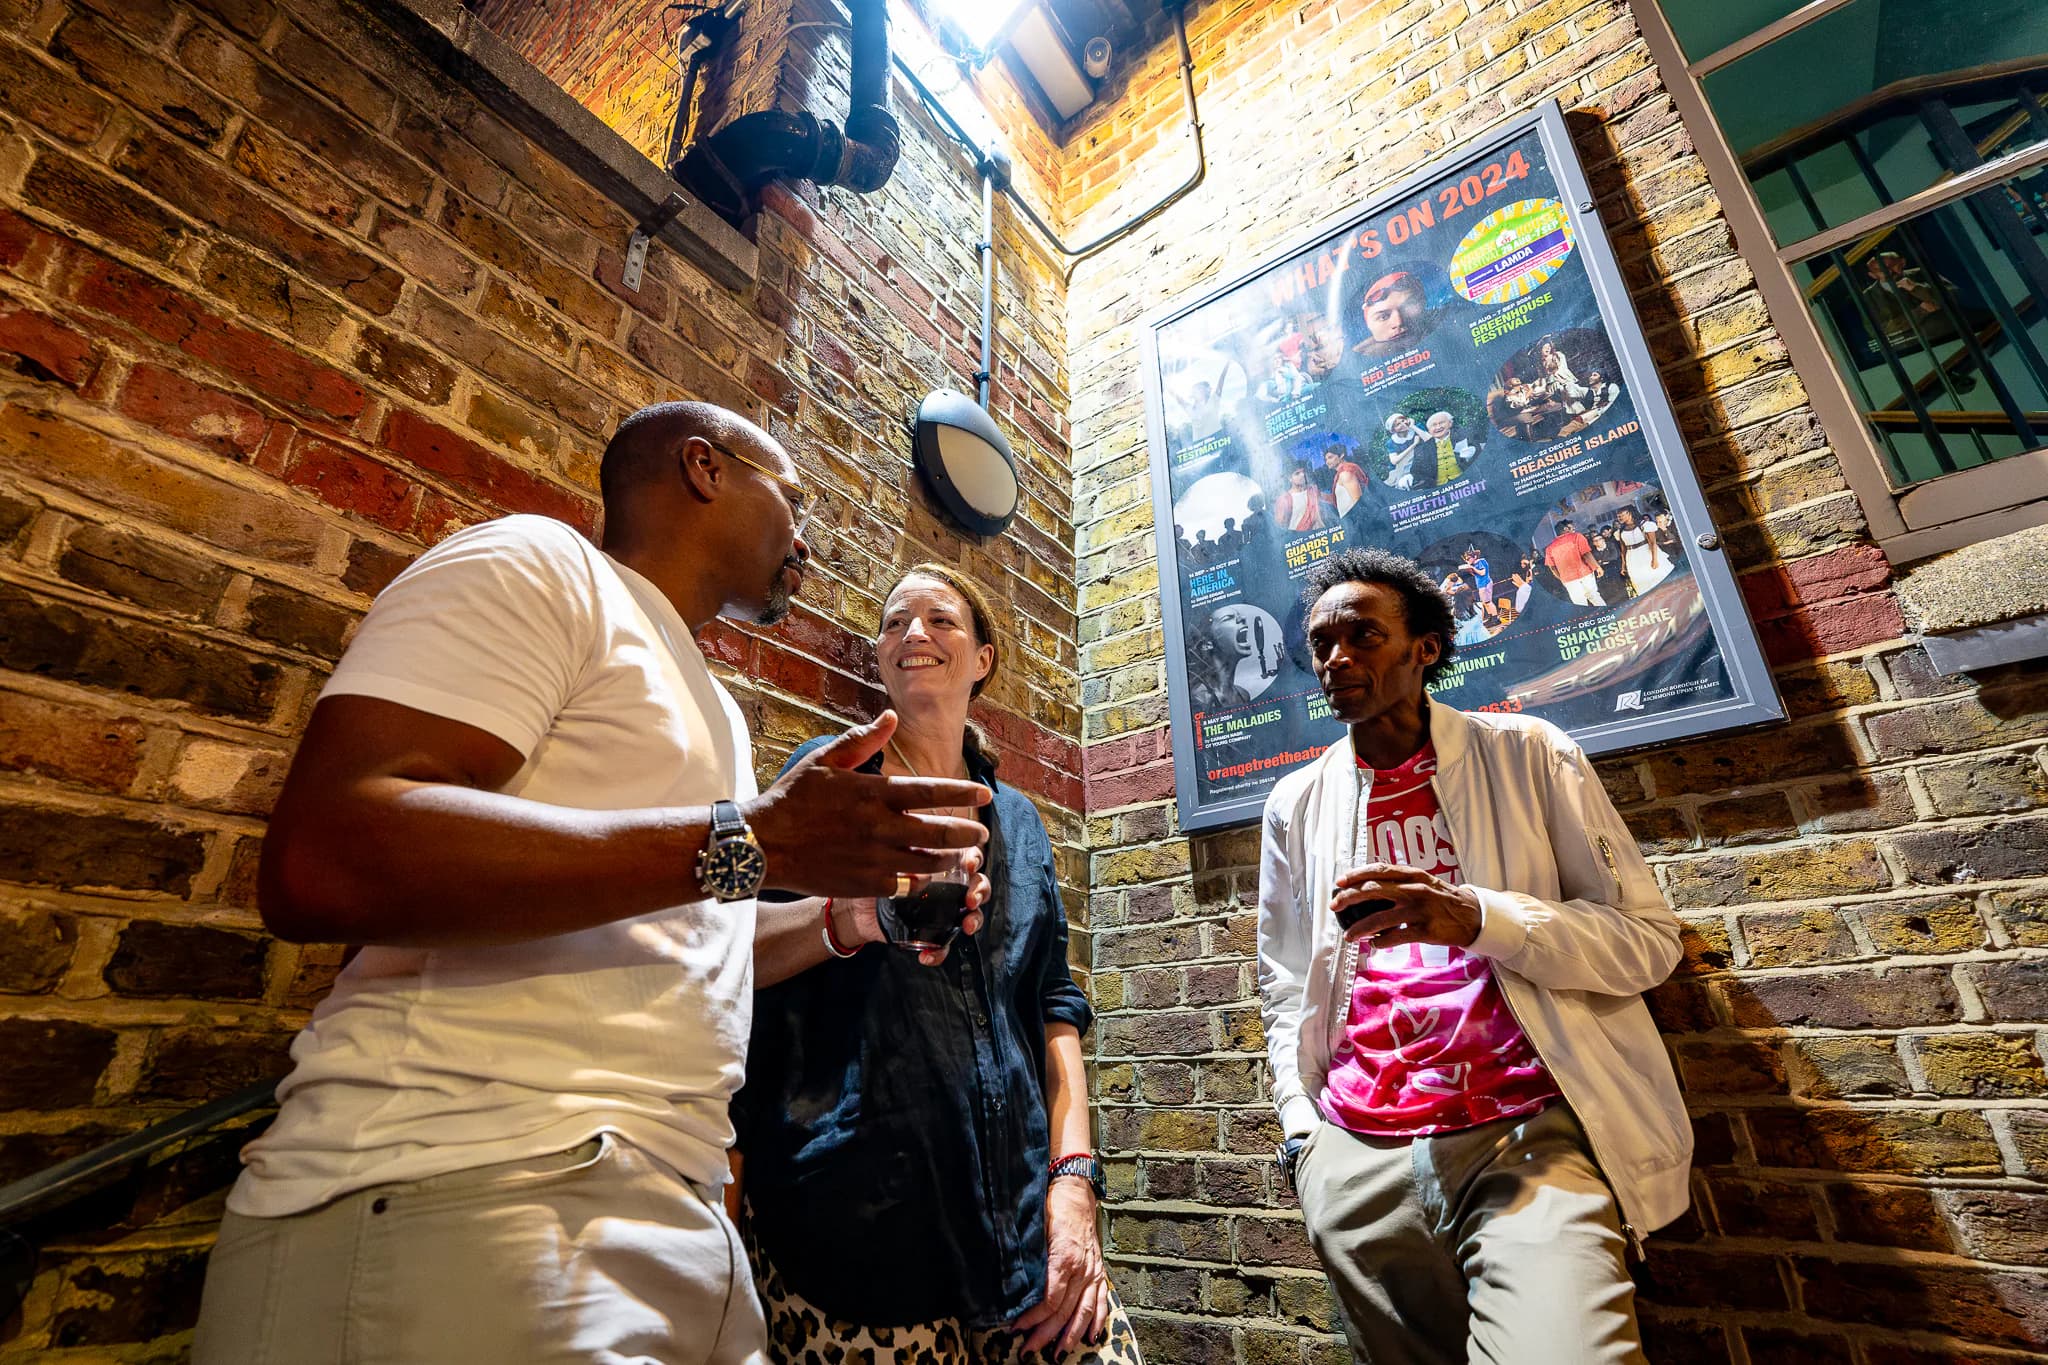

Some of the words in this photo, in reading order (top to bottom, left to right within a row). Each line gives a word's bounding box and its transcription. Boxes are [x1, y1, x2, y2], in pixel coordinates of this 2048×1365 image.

[1271, 229, 1382, 306] WHAT'S
[1387, 200, 1435, 245] ON
[1439, 150, 1530, 220] 2024
[1494, 247, 1533, 273] LAMDA
[1471, 292, 1553, 337] GREENHOUSE
[1478, 315, 1491, 324] AUG
[1502, 303, 1515, 312] SEP
[1516, 296, 1532, 306] 2024
[1474, 315, 1532, 347] FESTIVAL
[1362, 370, 1384, 386] RED
[1387, 350, 1430, 375] SPEEDO
[1266, 409, 1293, 428] SUITE
[1295, 404, 1306, 414] IN
[1268, 416, 1297, 436] THREE
[1300, 404, 1327, 421] KEYS
[1177, 436, 1231, 463] TESTMATCH
[1510, 443, 1582, 478] TREASURE
[1584, 421, 1639, 450] ISLAND
[1517, 455, 1532, 464] DEC
[1548, 443, 1564, 452] DEC
[1564, 436, 1582, 446] 2024
[1516, 484, 1537, 496] directed
[1545, 472, 1572, 486] NATASHA
[1573, 460, 1601, 475] RICKMAN
[1521, 471, 1545, 483] HANNAH
[1546, 463, 1567, 473] KHALIL
[1559, 457, 1594, 475] STEVENSON
[1390, 495, 1446, 520] TWELFTH
[1450, 480, 1486, 502] NIGHT
[1397, 500, 1411, 508] NOV
[1412, 494, 1426, 503] 2024
[1441, 485, 1454, 493] JAN
[1394, 524, 1412, 533] directed
[1432, 510, 1453, 520] LITTLER
[1399, 515, 1420, 526] WILLIAM
[1422, 502, 1460, 518] SHAKESPEARE
[1329, 525, 1342, 534] 2024
[1286, 537, 1328, 558] GUARDS
[1332, 530, 1344, 543] AT
[1287, 554, 1307, 568] THE
[1309, 546, 1330, 560] TAJ
[1190, 573, 1214, 588] HERE
[1217, 569, 1227, 578] IN
[1191, 577, 1235, 598] AMERICA
[1555, 626, 1571, 635] NOV
[1578, 619, 1595, 628] DEC
[1598, 614, 1615, 624] 2024
[1557, 608, 1672, 649] SHAKESPEARE
[1560, 646, 1580, 660] UP
[1586, 632, 1637, 654] CLOSE
[1307, 693, 1319, 701] MAY
[1643, 692, 1675, 702] RICHMOND
[1694, 681, 1720, 690] THAMES
[1644, 687, 1668, 696] LONDON
[1669, 680, 1699, 690] BOROUGH
[1308, 697, 1328, 709] PRIM
[1204, 724, 1224, 736] THE
[1227, 709, 1282, 732] MALADIES
[1229, 735, 1252, 743] COMPANY
[1210, 786, 1234, 794] Registered
